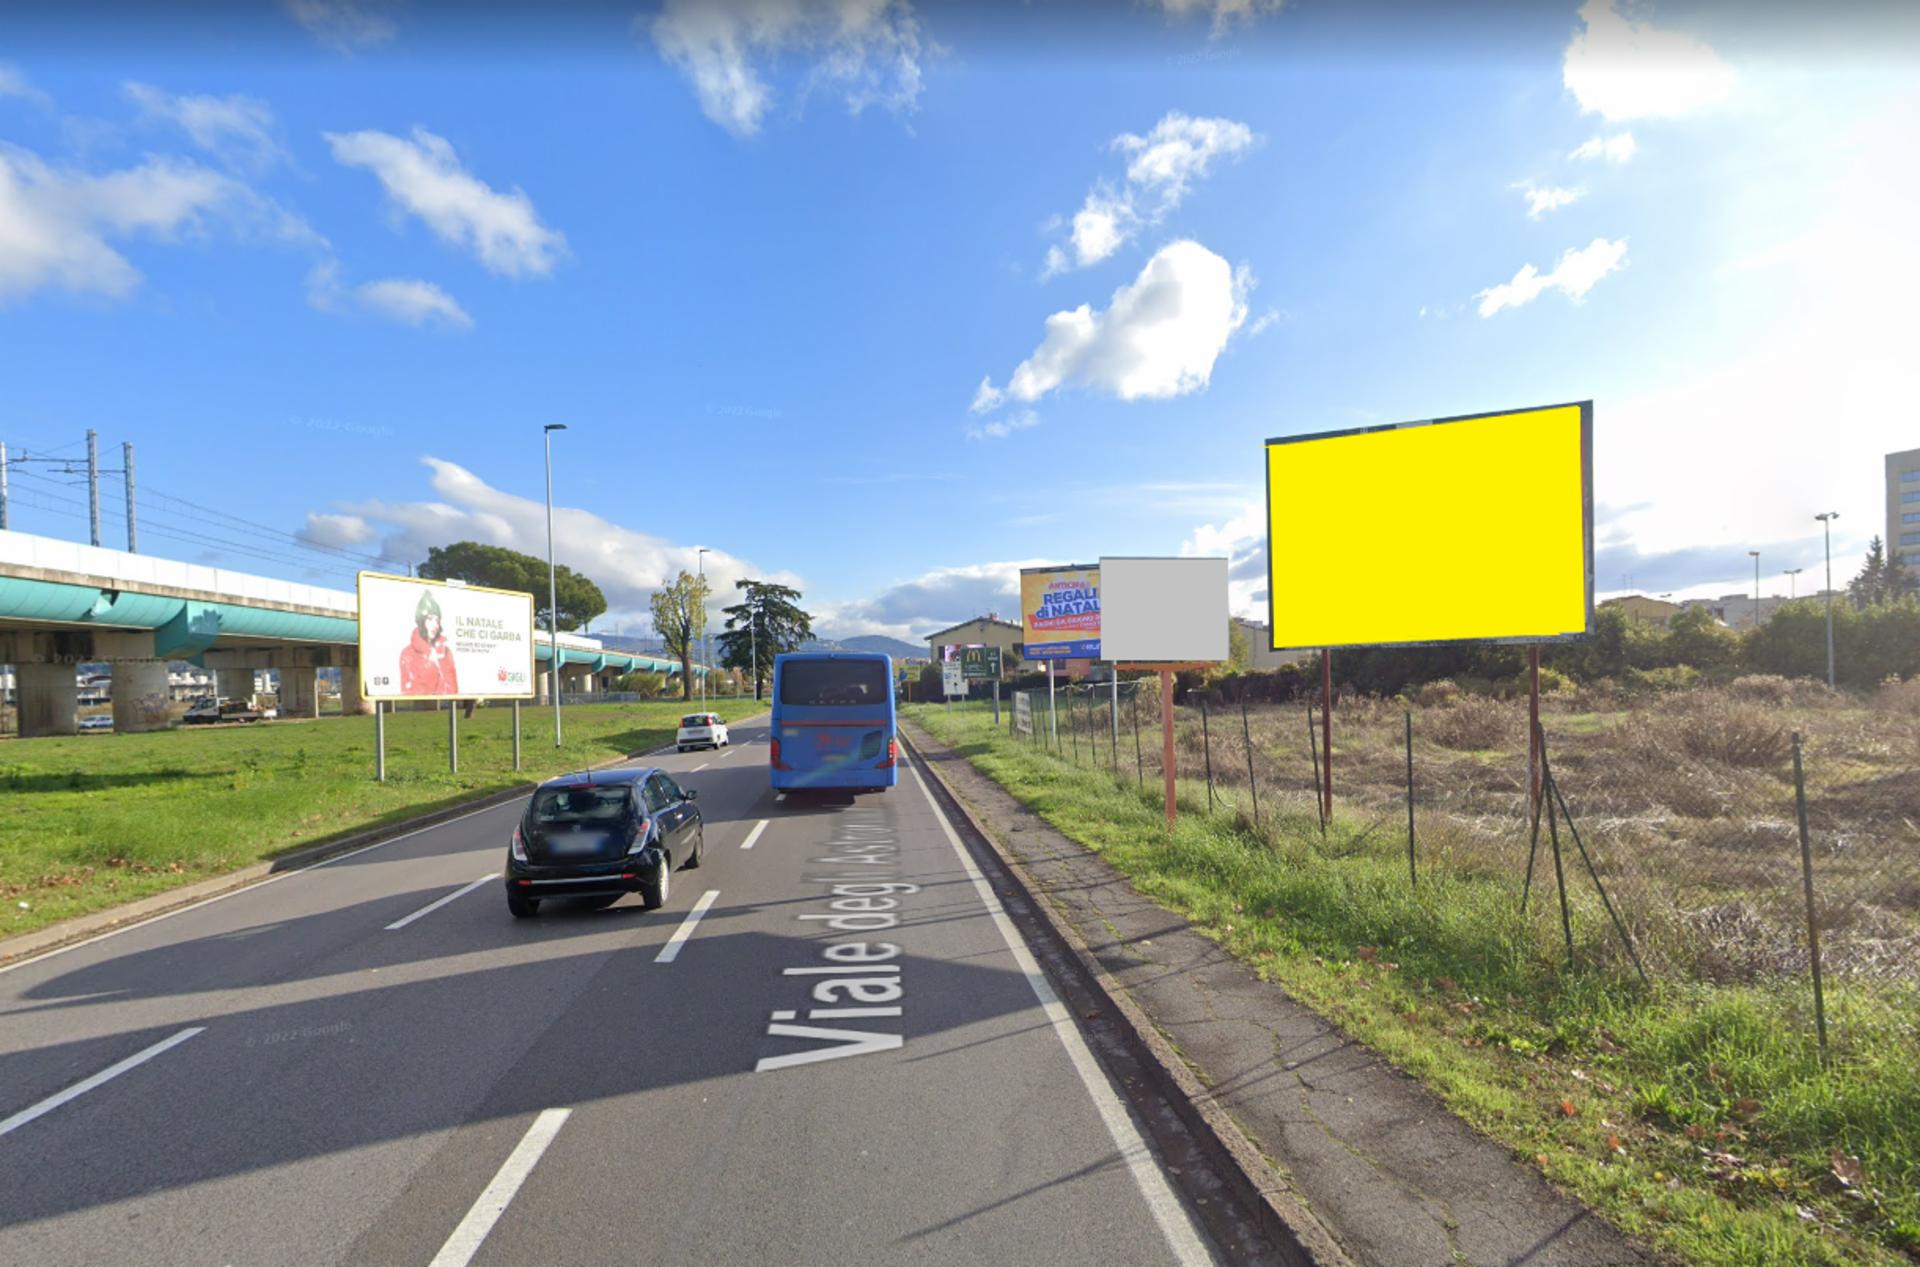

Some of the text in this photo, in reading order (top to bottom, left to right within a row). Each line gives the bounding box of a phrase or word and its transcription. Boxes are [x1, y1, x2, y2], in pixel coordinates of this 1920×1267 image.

[1043, 587, 1097, 606] REGALI
[1036, 606, 1050, 619] di
[1051, 600, 1100, 617] NATAL
[456, 616, 503, 629] IL NATALE
[456, 628, 521, 641] CHE CI GARBA
